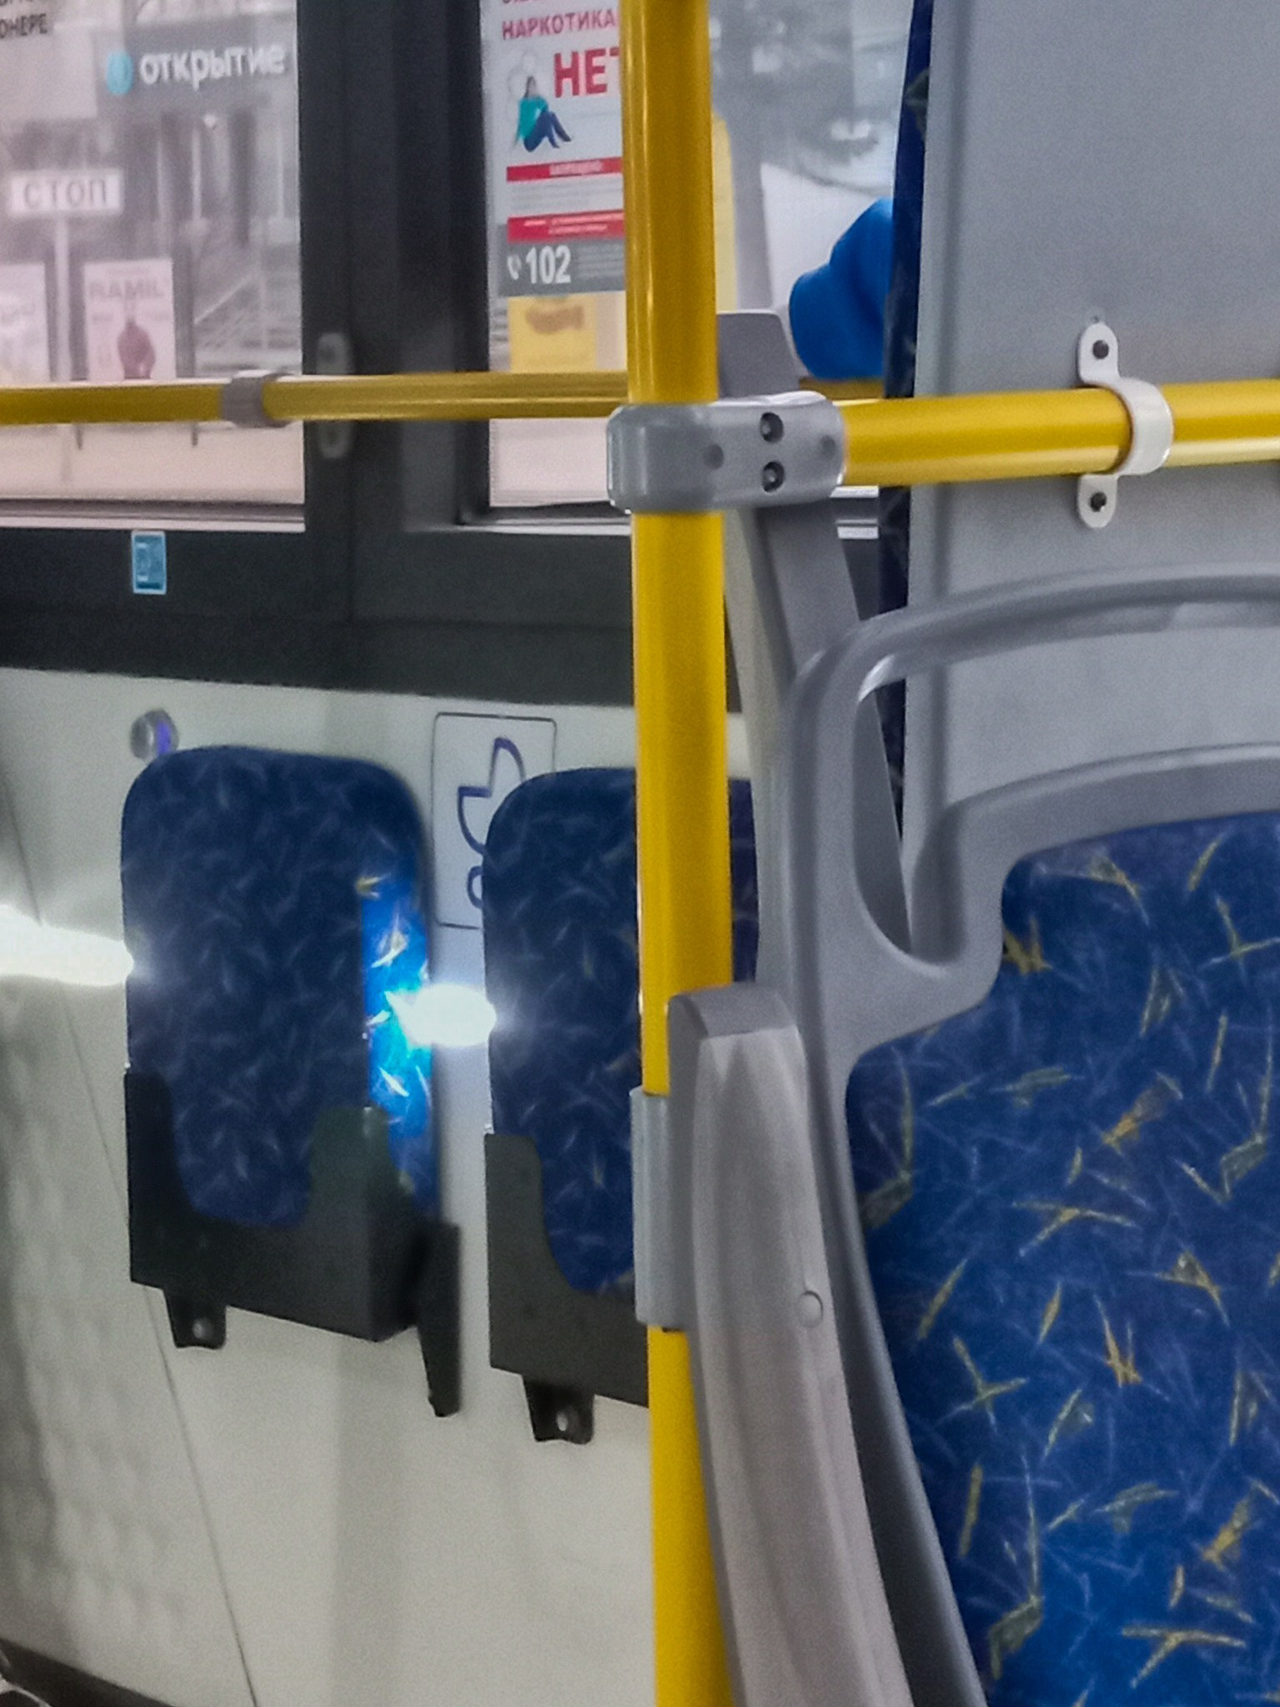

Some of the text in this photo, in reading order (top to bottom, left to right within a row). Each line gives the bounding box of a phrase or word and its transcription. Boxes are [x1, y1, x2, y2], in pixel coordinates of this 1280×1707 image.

[0, 12, 49, 40] ОНЕРЕ
[502, 8, 618, 41] НАРКОТИКА
[140, 45, 286, 91] открытие
[525, 244, 572, 285] 102
